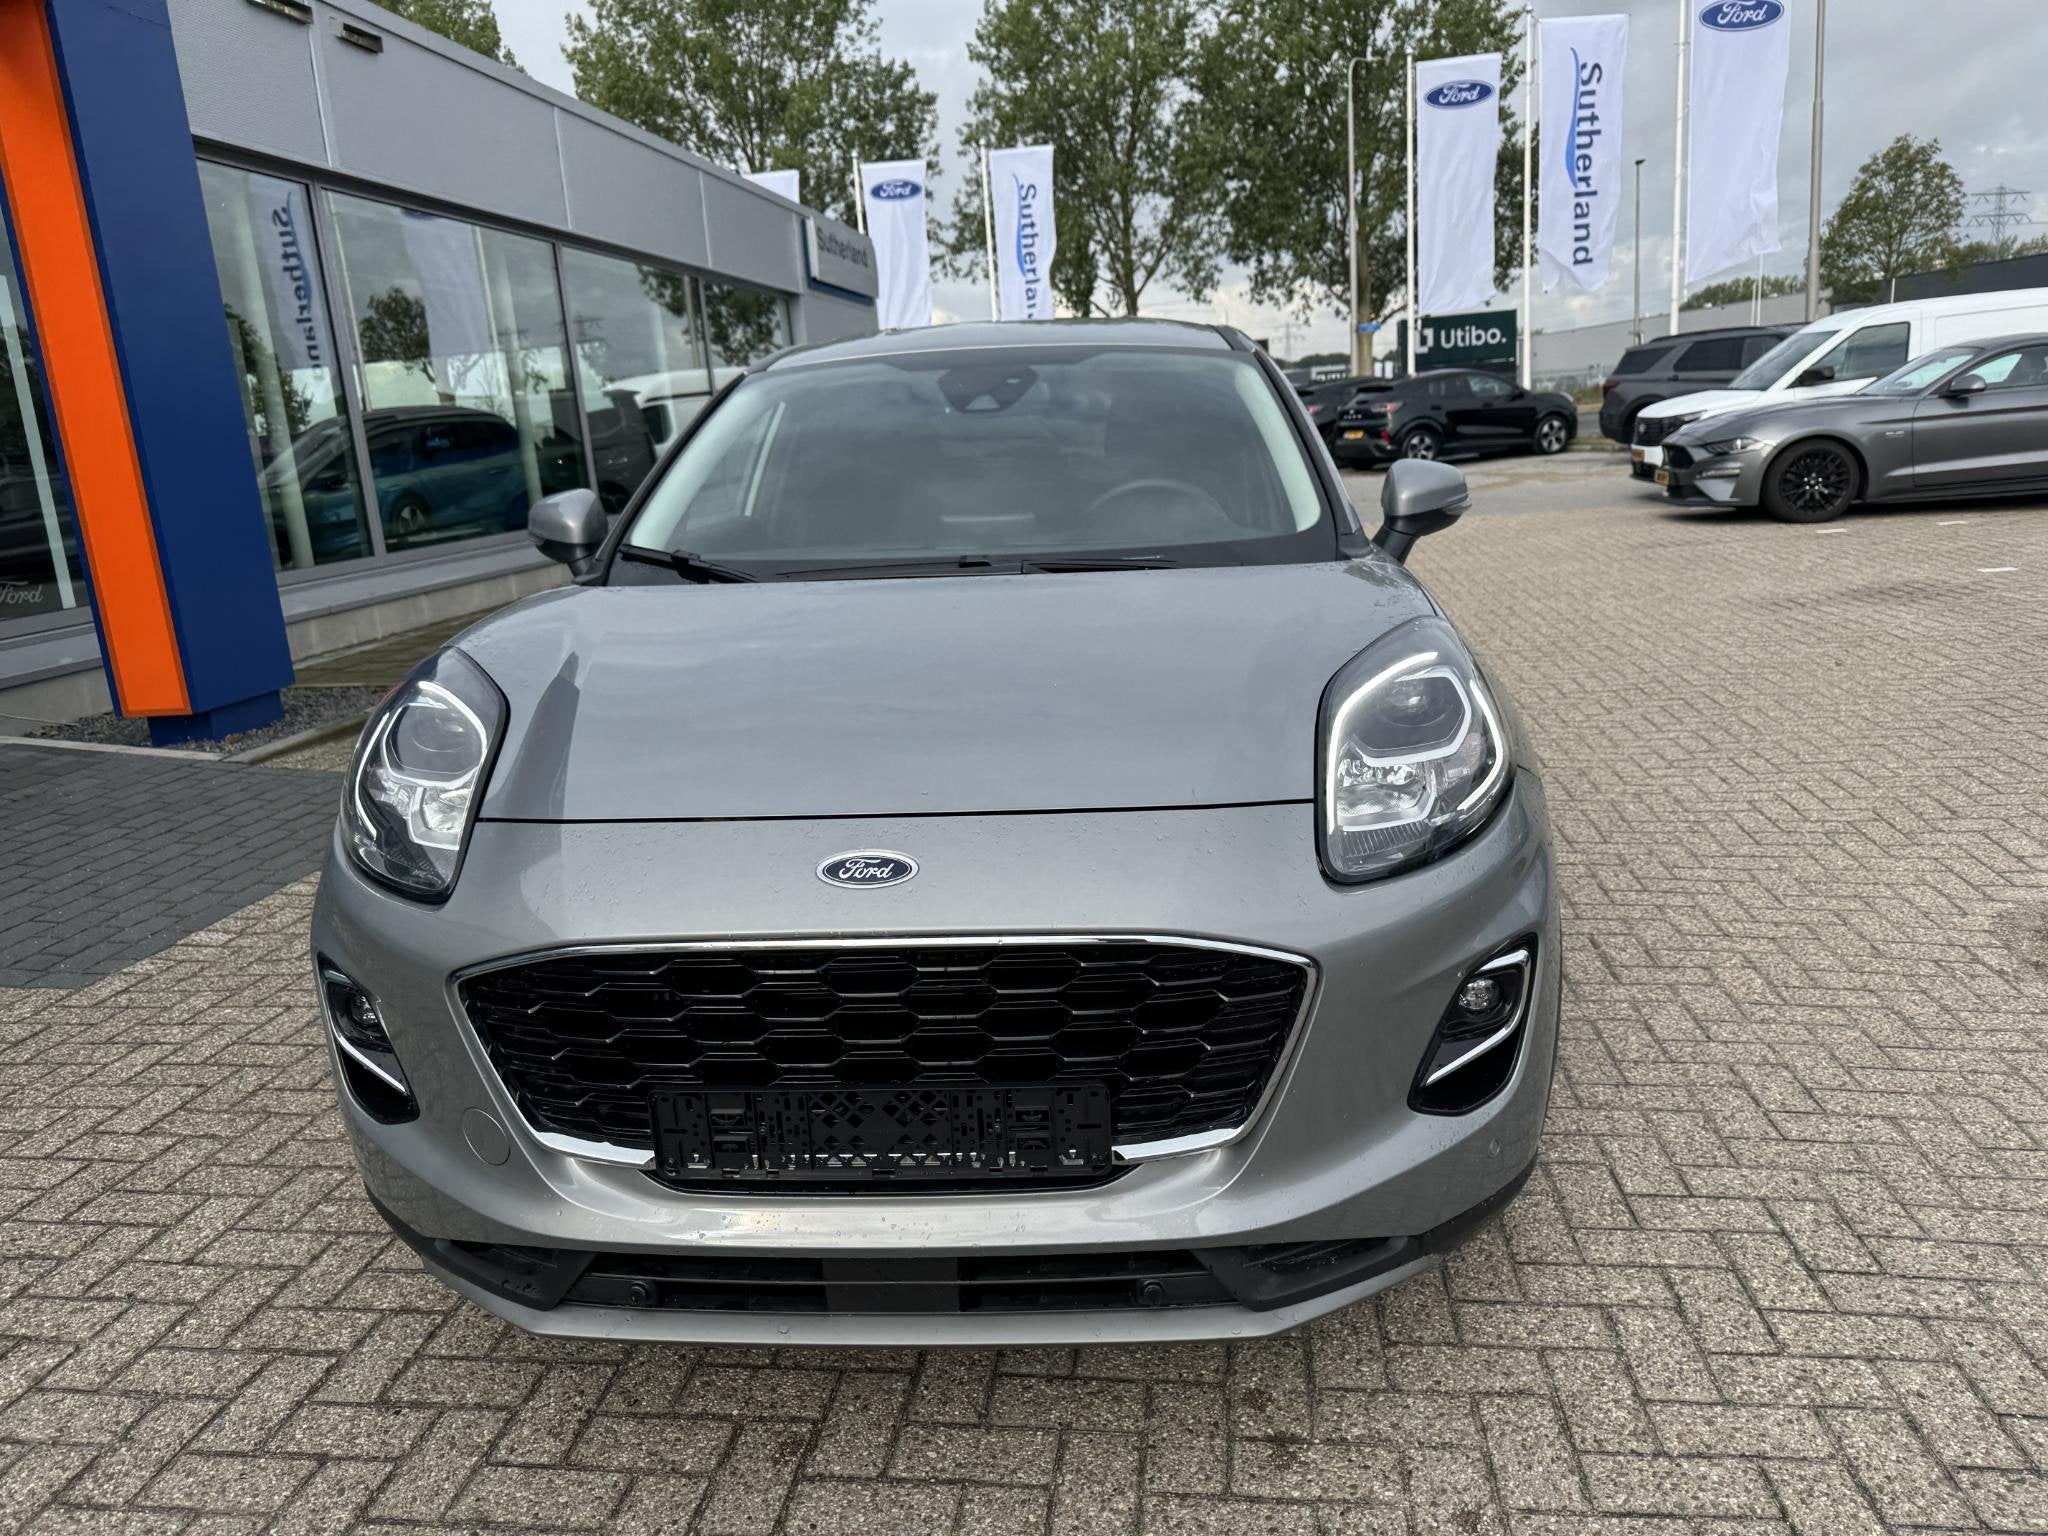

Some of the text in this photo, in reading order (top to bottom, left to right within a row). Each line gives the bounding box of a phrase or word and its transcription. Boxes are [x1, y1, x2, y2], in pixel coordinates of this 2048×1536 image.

[1717, 0, 1768, 24] Ford
[1438, 83, 1481, 104] Ford
[1573, 62, 1603, 266] Sutherland
[880, 181, 912, 198] Ford
[1440, 325, 1508, 348] Utibo.
[838, 858, 895, 878] Ford
